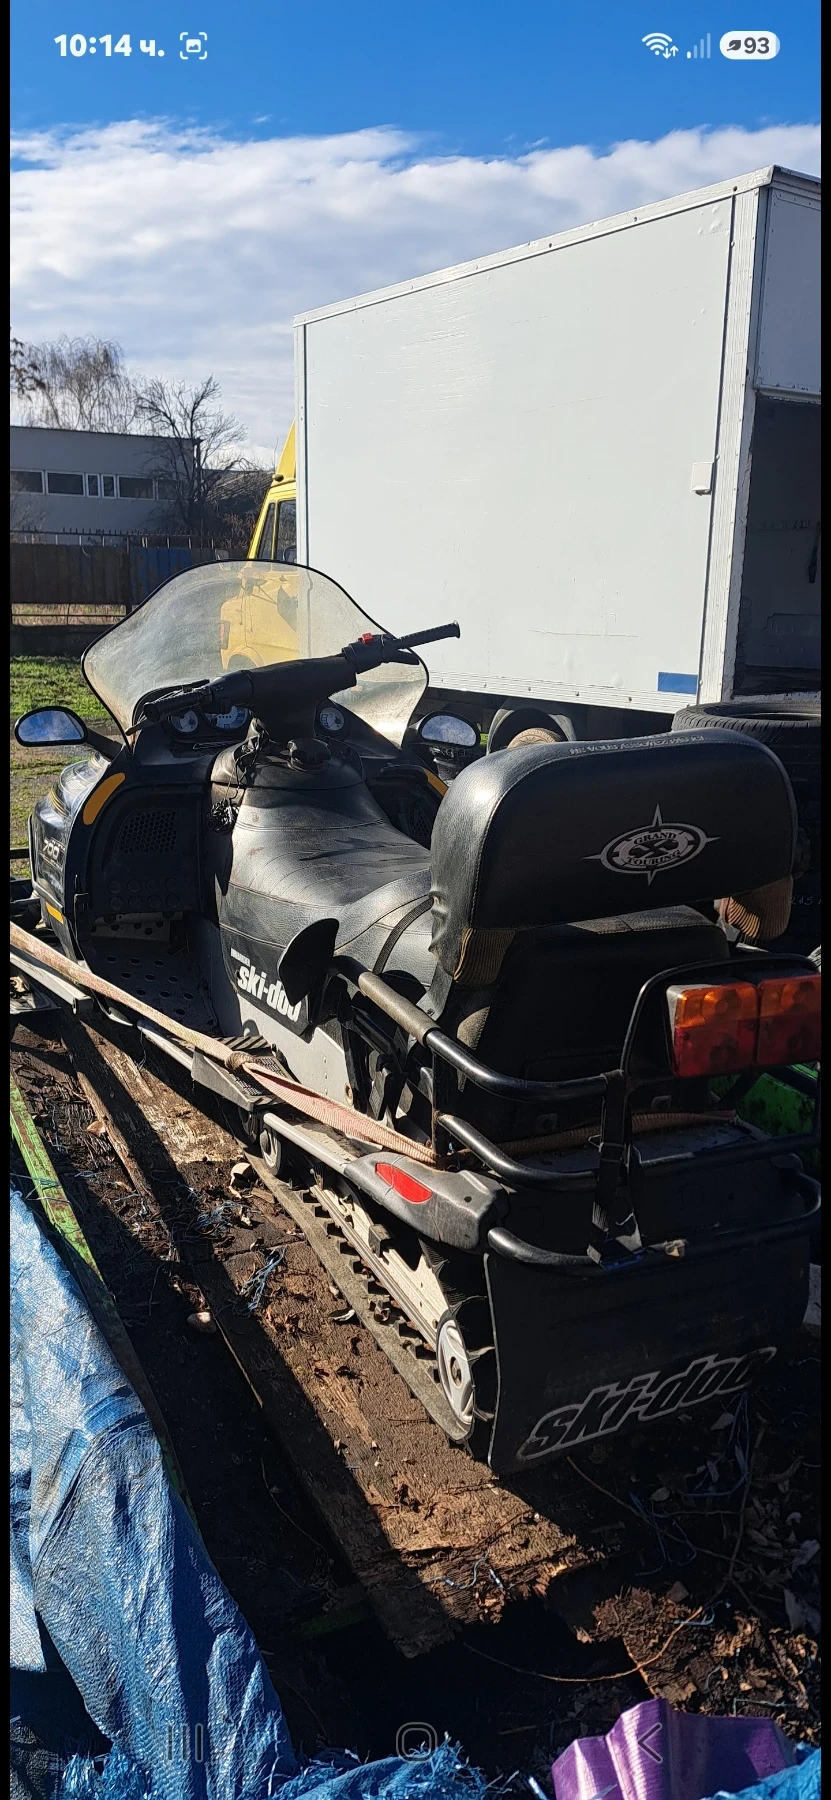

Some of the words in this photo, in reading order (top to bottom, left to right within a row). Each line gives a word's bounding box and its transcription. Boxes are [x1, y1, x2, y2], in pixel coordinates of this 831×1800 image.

[633, 832, 677, 845] GRAND
[42, 838, 60, 861] 700
[626, 849, 681, 866] TOURING
[516, 1346, 777, 1461] ski-doo
